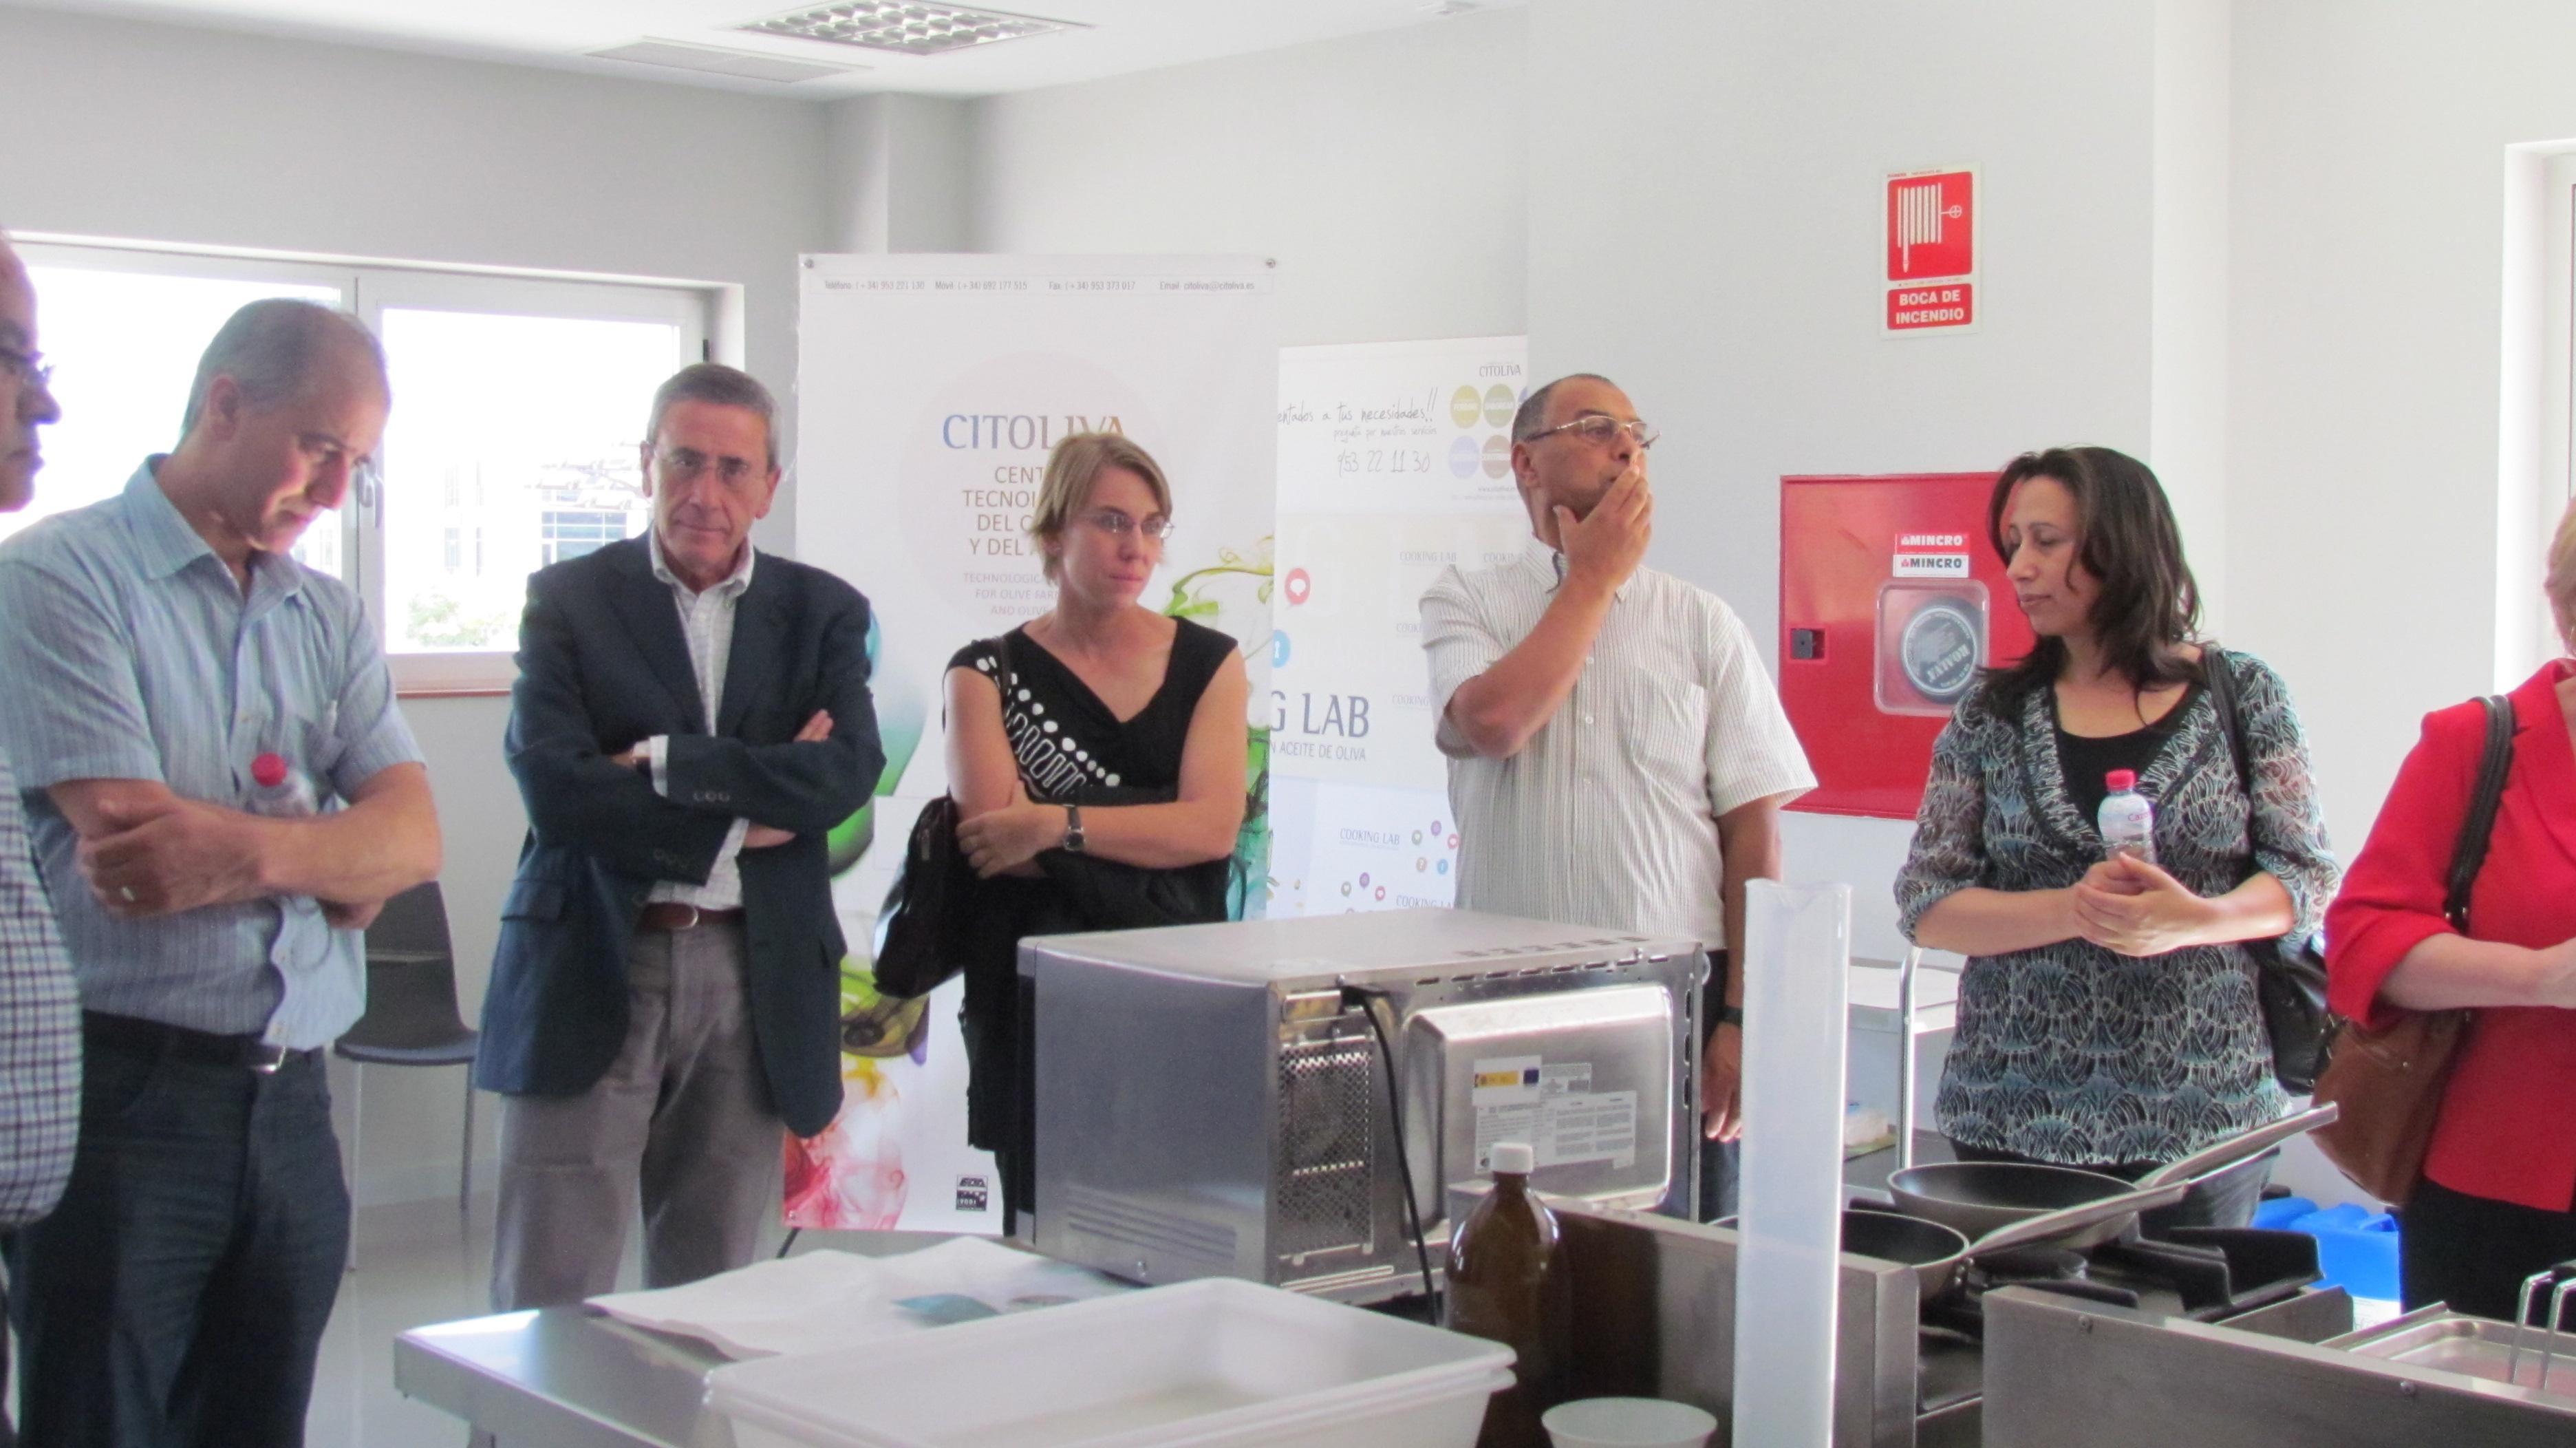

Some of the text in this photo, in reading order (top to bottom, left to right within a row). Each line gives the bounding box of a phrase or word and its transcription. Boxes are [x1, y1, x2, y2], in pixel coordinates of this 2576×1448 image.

[1899, 289, 1961, 306] BOCA DE
[1896, 307, 1964, 325] INCENDIO
[1479, 363, 1522, 377] CITOLIVA
[1322, 411, 1331, 420] a
[1337, 402, 1353, 423] tus
[1338, 447, 1431, 478] 953 22 11 30
[994, 466, 1044, 484] CENT
[977, 514, 1014, 531] DEL
[969, 538, 980, 555] Y
[988, 538, 1024, 556] DEL
[1910, 535, 1964, 546] MINCRO
[1399, 551, 1457, 563] COOKING LAB
[1909, 557, 1962, 569] MINCRO
[963, 573, 1041, 584] TECHNOLOGIC
[975, 589, 996, 600] FOR
[1000, 589, 1031, 600] OLIVE
[991, 605, 1015, 616] AND
[1396, 622, 1422, 634] COOK
[1300, 692, 1370, 738] LAB
[1279, 741, 1315, 758] ACEITE
[1318, 744, 1333, 760] DE
[1336, 745, 1366, 762] OLIVA
[1340, 827, 1400, 846] COOKING LAB
